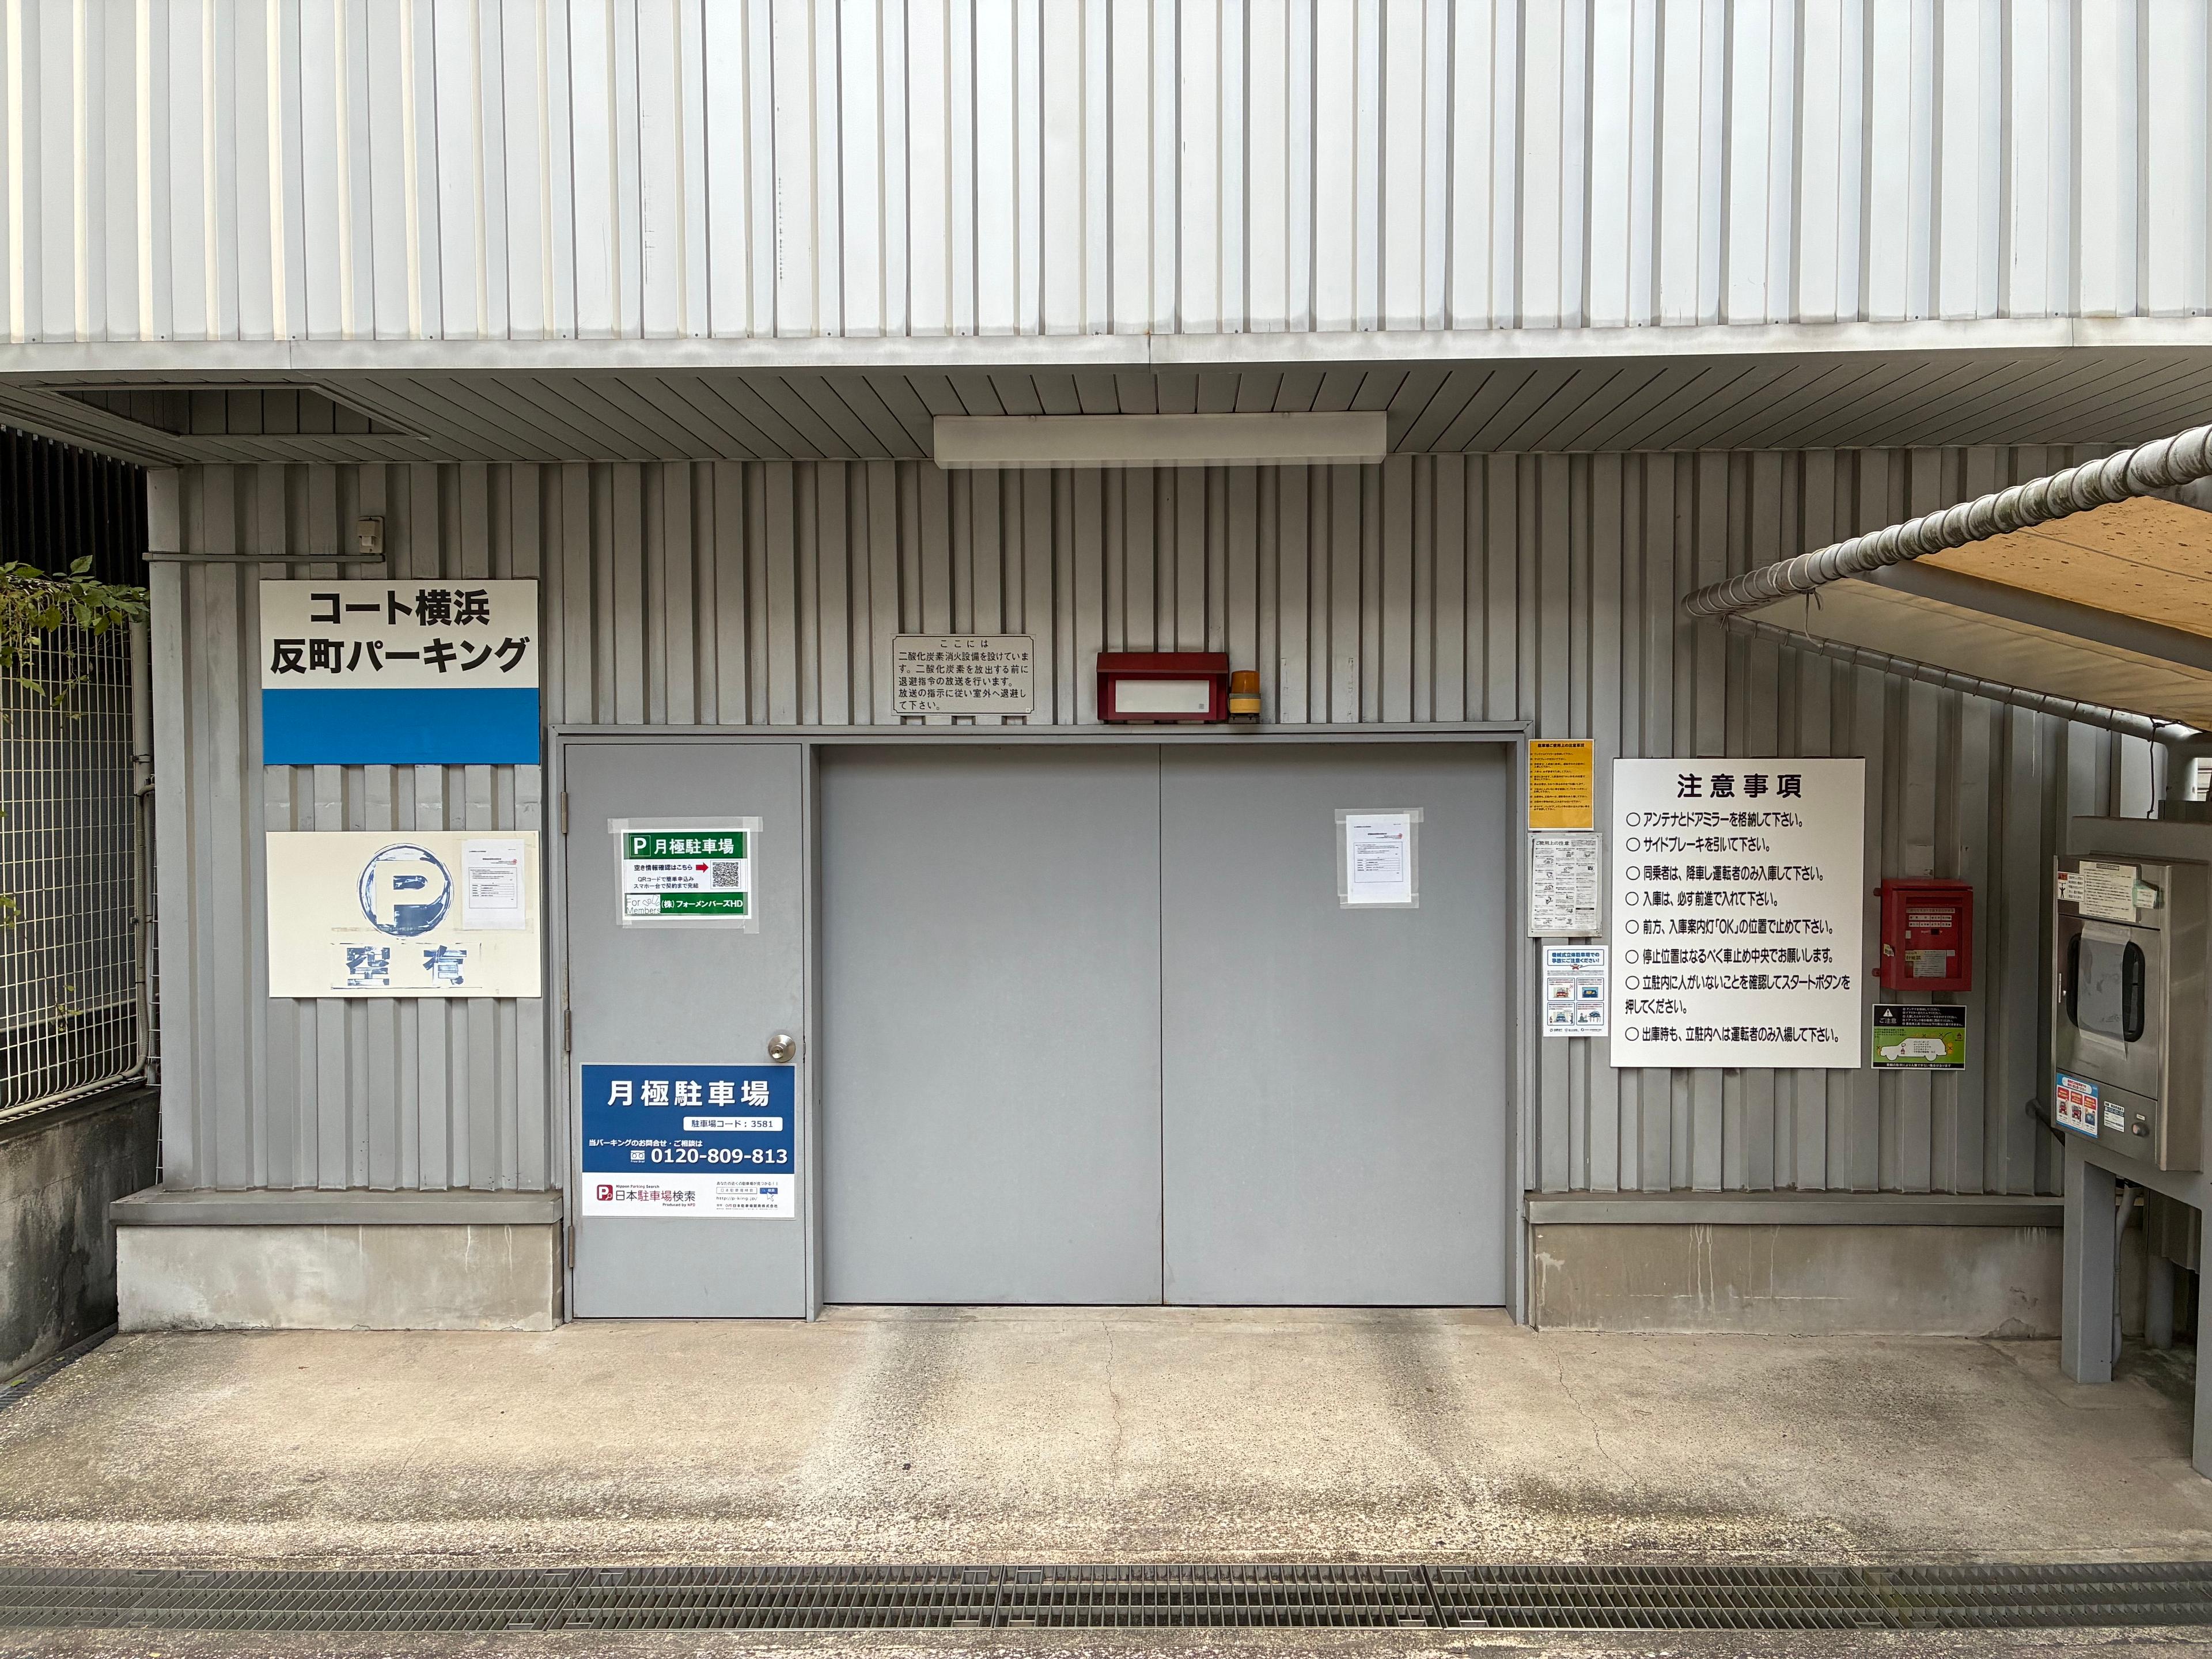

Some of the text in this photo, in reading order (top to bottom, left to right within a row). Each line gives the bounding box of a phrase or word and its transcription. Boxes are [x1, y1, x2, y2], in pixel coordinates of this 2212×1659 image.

[310, 589, 490, 626] コート横浜
[941, 639, 989, 648] ここには
[270, 636, 531, 674] 反町パーキング
[898, 652, 1029, 662] 二酸化炭素消火設備を設けていま
[898, 664, 1029, 674] す。二酸化炭素を放出する前に
[898, 676, 1013, 687] 退避指令の放送を行います。
[898, 689, 1027, 698] 放送の指示に従い室外へ退避し
[899, 700, 940, 711] て下さい。
[1677, 773, 1802, 798] 注意事項
[1643, 811, 1803, 828] アンテナとドアミラーを格納して下さい。
[633, 838, 734, 855] P 月極駐車場
[1643, 836, 1770, 853] サイドブレーキを引いて下さい。
[1643, 865, 1824, 881] 同乗者は、降車し運転者のみ入庫して下さい。
[626, 898, 641, 907] For
[1642, 919, 1834, 935] 前方、入庫案内灯「OK」の位置で止めて下さい。
[1642, 948, 1834, 964] 停止位置はなるべく車止め中央でお願いします。
[1642, 974, 1851, 991] 立駐内に人がいないことを確認してスタートボタンを
[1624, 998, 1687, 1014] 押してください。
[1642, 1026, 1840, 1043] 出庫時も、立駐内へは運転者のみ入場して下さい。
[607, 1080, 770, 1107] 月極駐車場
[651, 1148, 788, 1164] 0120-809-813
[616, 1190, 696, 1202] 日本駐車場検索
